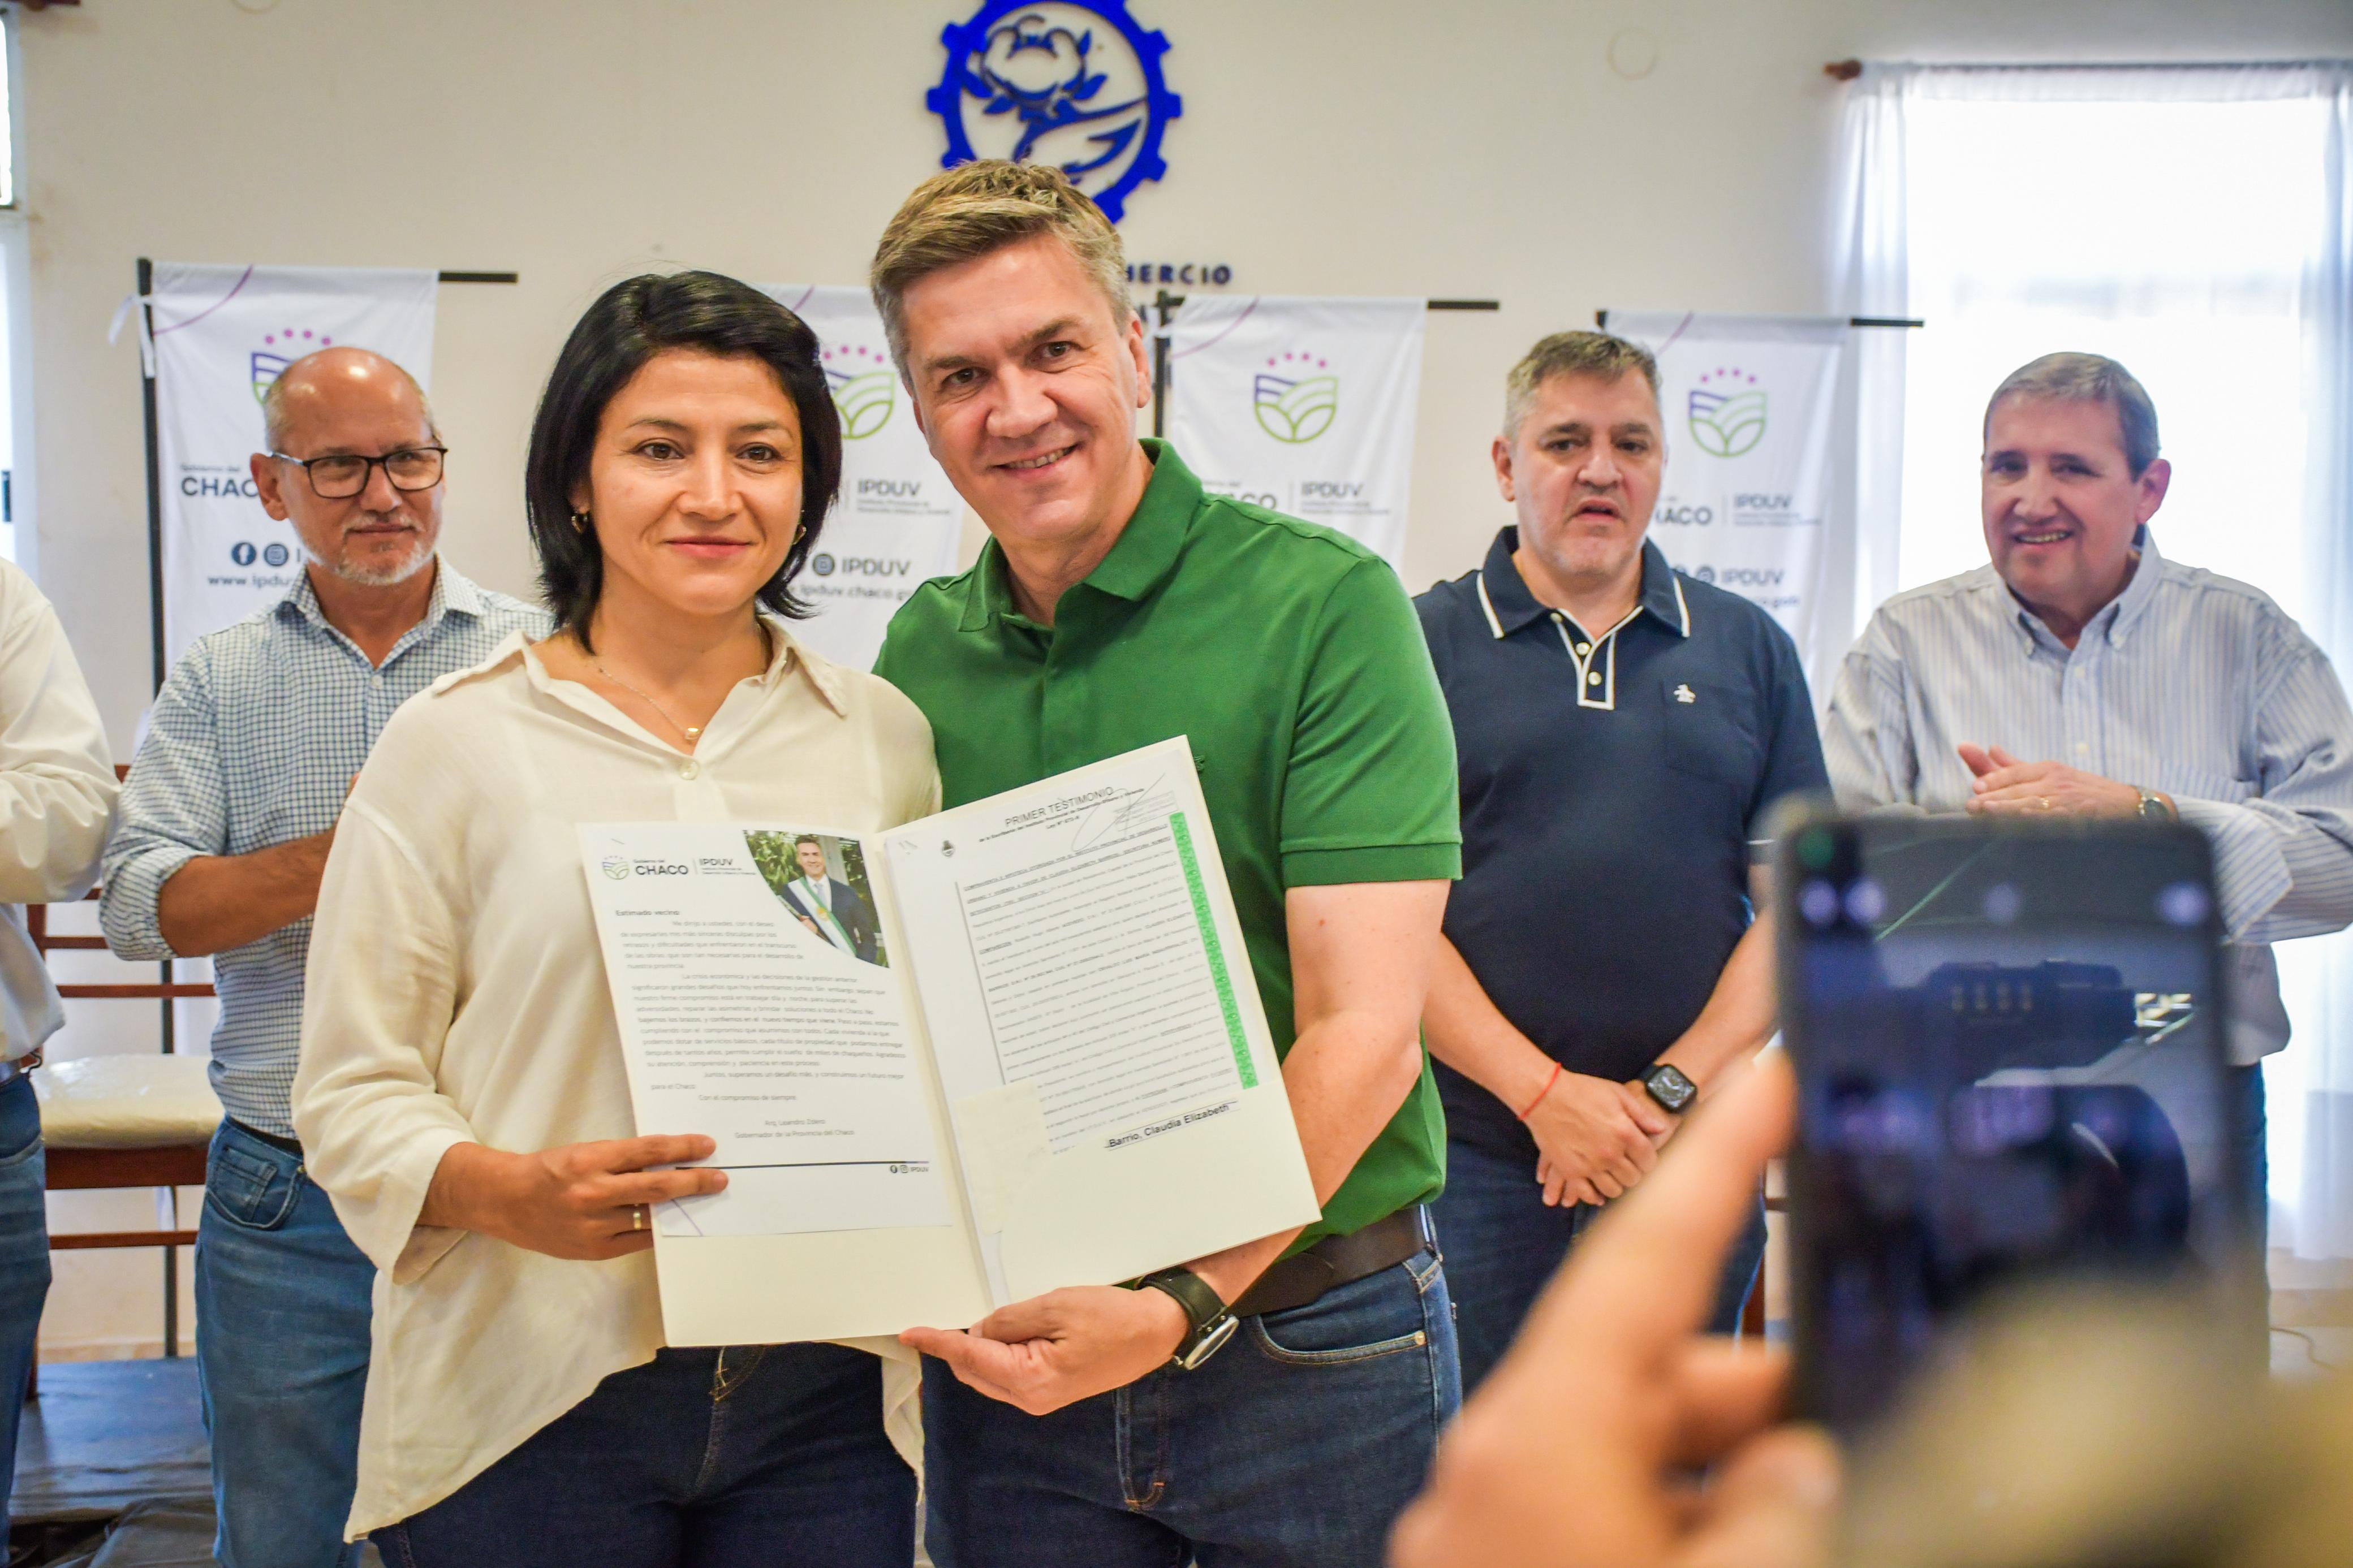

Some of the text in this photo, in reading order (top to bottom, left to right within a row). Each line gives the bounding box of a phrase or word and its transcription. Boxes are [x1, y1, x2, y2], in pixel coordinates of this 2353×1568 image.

[1126, 264, 1231, 285] ERCIO
[182, 477, 258, 498] CHAC
[857, 479, 920, 496] IPDUV
[1303, 481, 1363, 498] IPDUV
[1734, 494, 1792, 509] IPDUV
[842, 557, 911, 576] IPDUV
[1721, 568, 1785, 585] IPDUV
[1005, 808, 1045, 826] PRIMER
[1048, 786, 1114, 813] TESTIMONIO
[635, 865, 689, 875] CHACO
[699, 858, 734, 866] IPDUV
[1143, 1119, 1182, 1136] Claudia
[1183, 1103, 1230, 1124] Elizabeth
